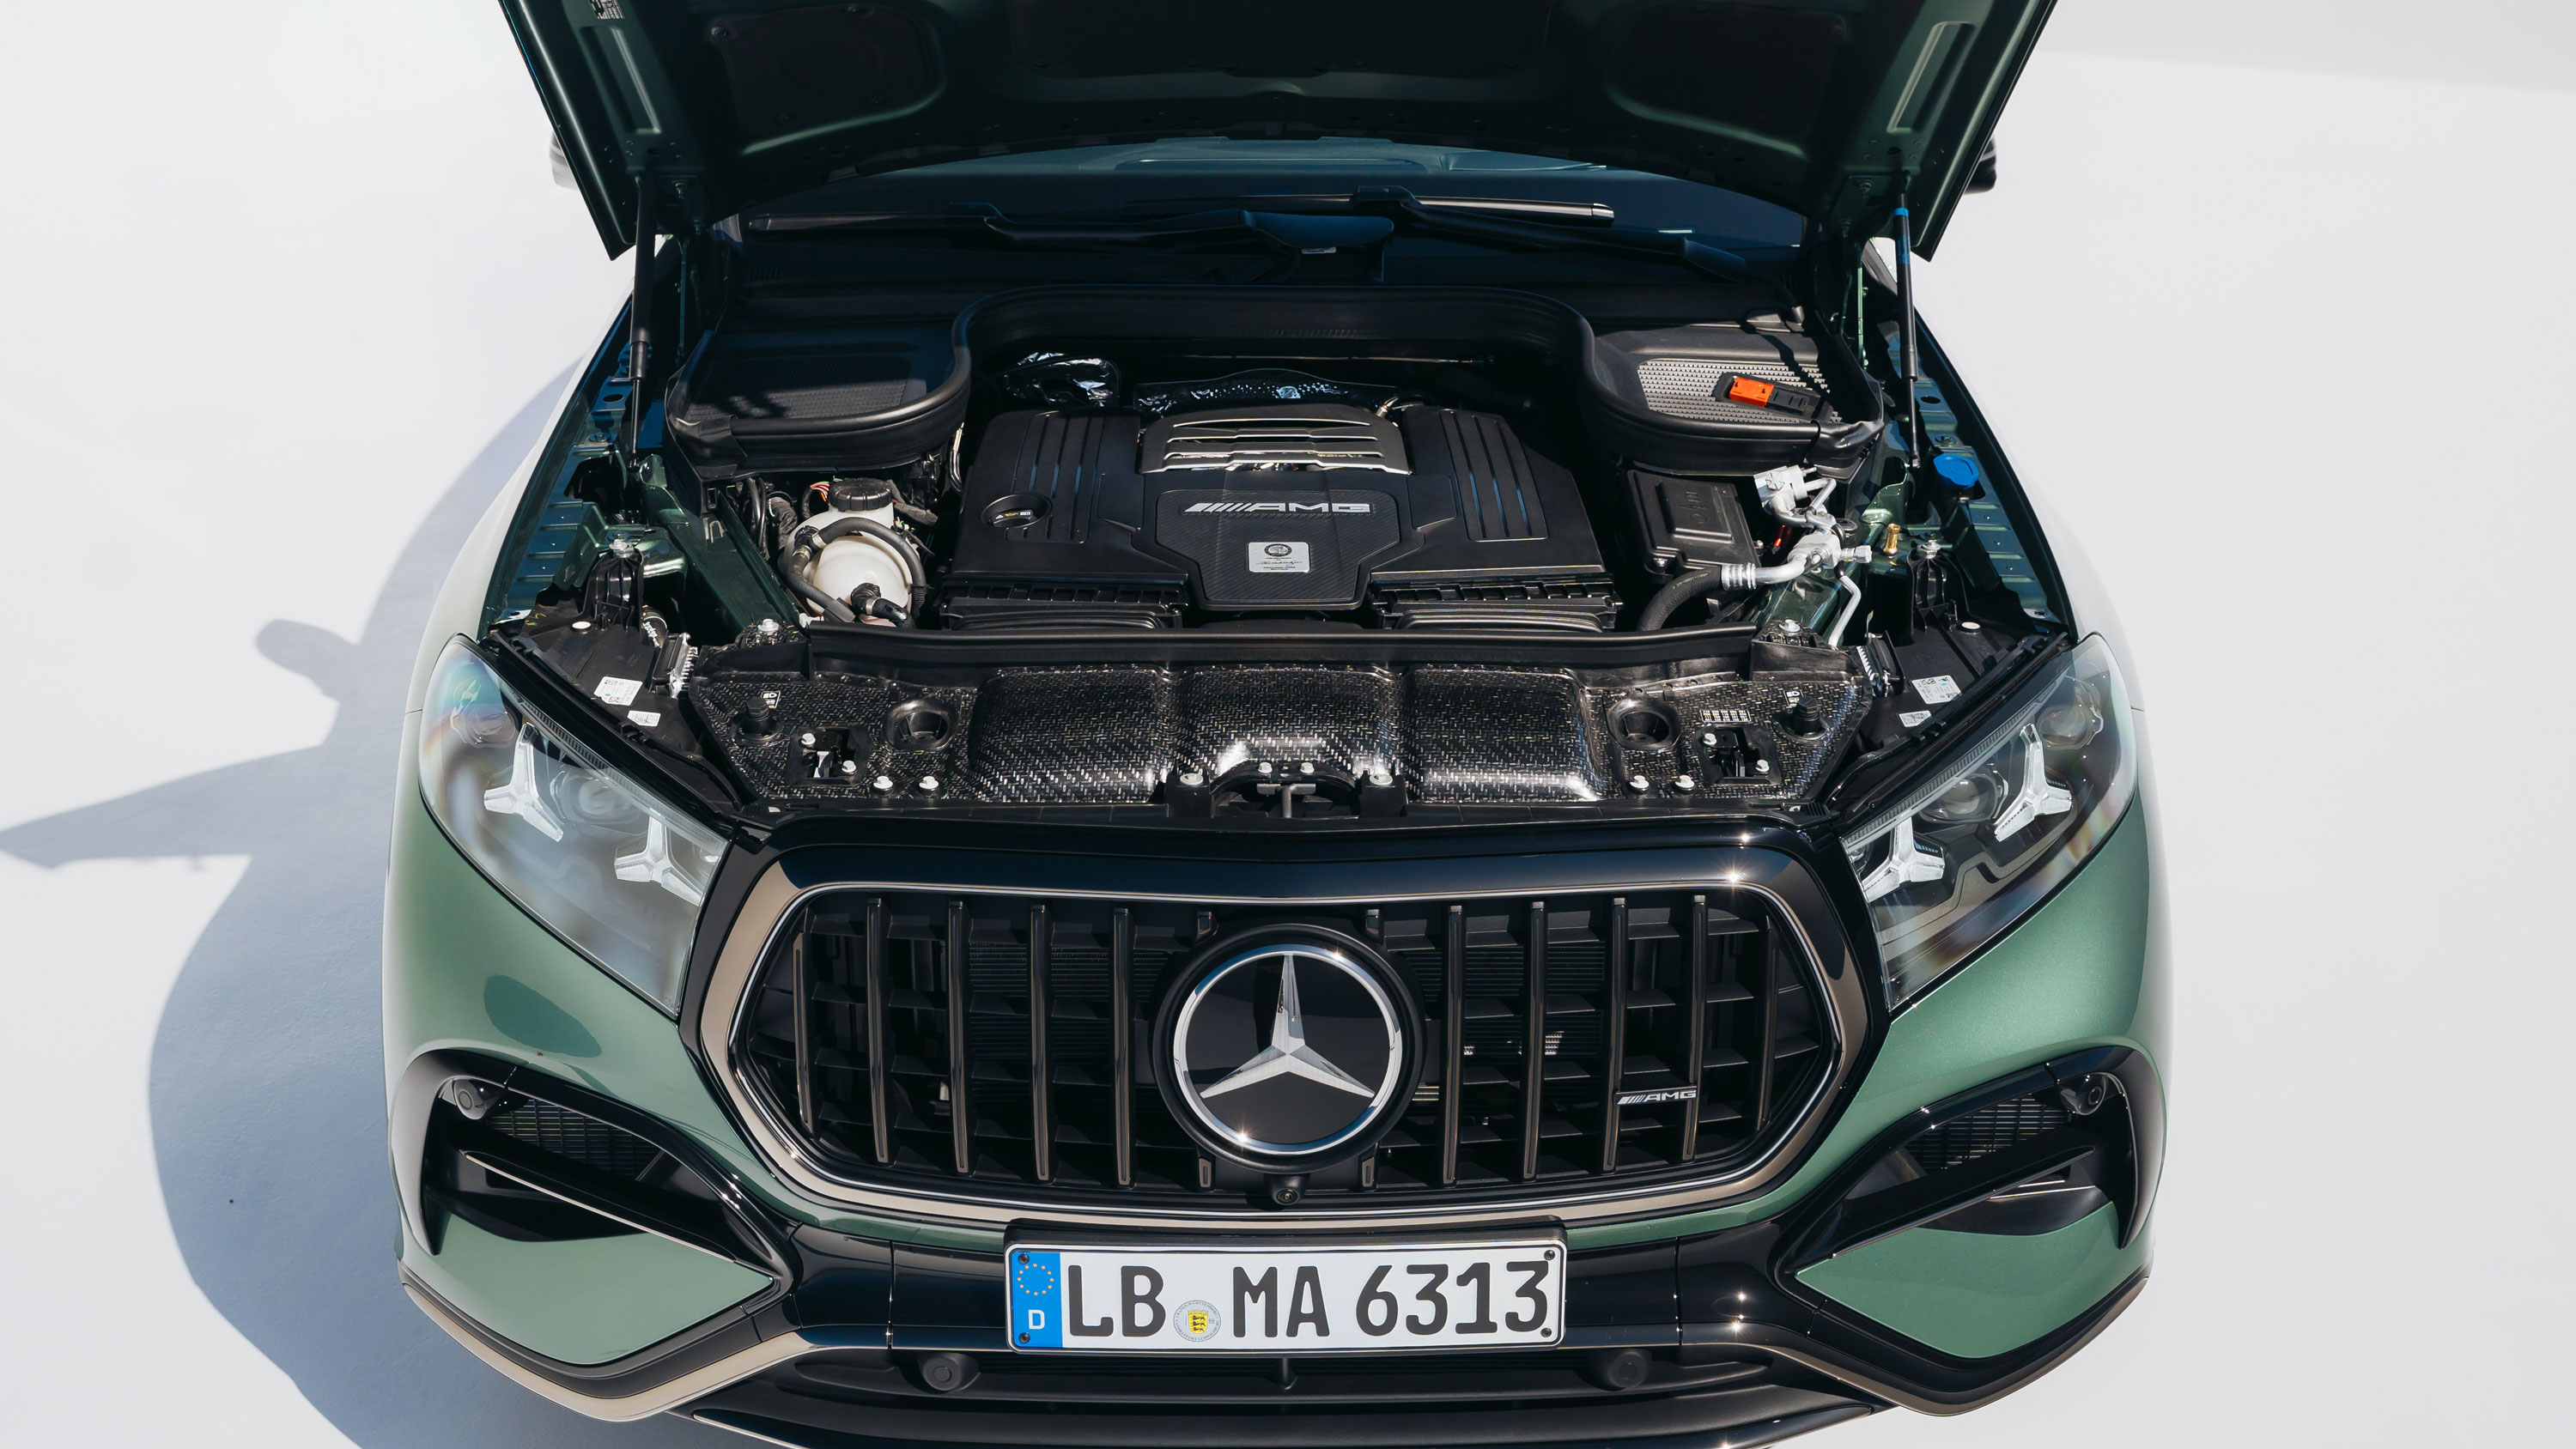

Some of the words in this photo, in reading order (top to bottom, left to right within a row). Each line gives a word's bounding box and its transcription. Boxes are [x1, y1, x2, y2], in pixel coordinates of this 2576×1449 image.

[1248, 502, 1370, 512] AMG
[1642, 1089, 1697, 1102] AMG
[1068, 1264, 1166, 1337] LB
[1232, 1265, 1330, 1338] MA
[1355, 1260, 1549, 1337] 6313
[1028, 1309, 1046, 1330] D
